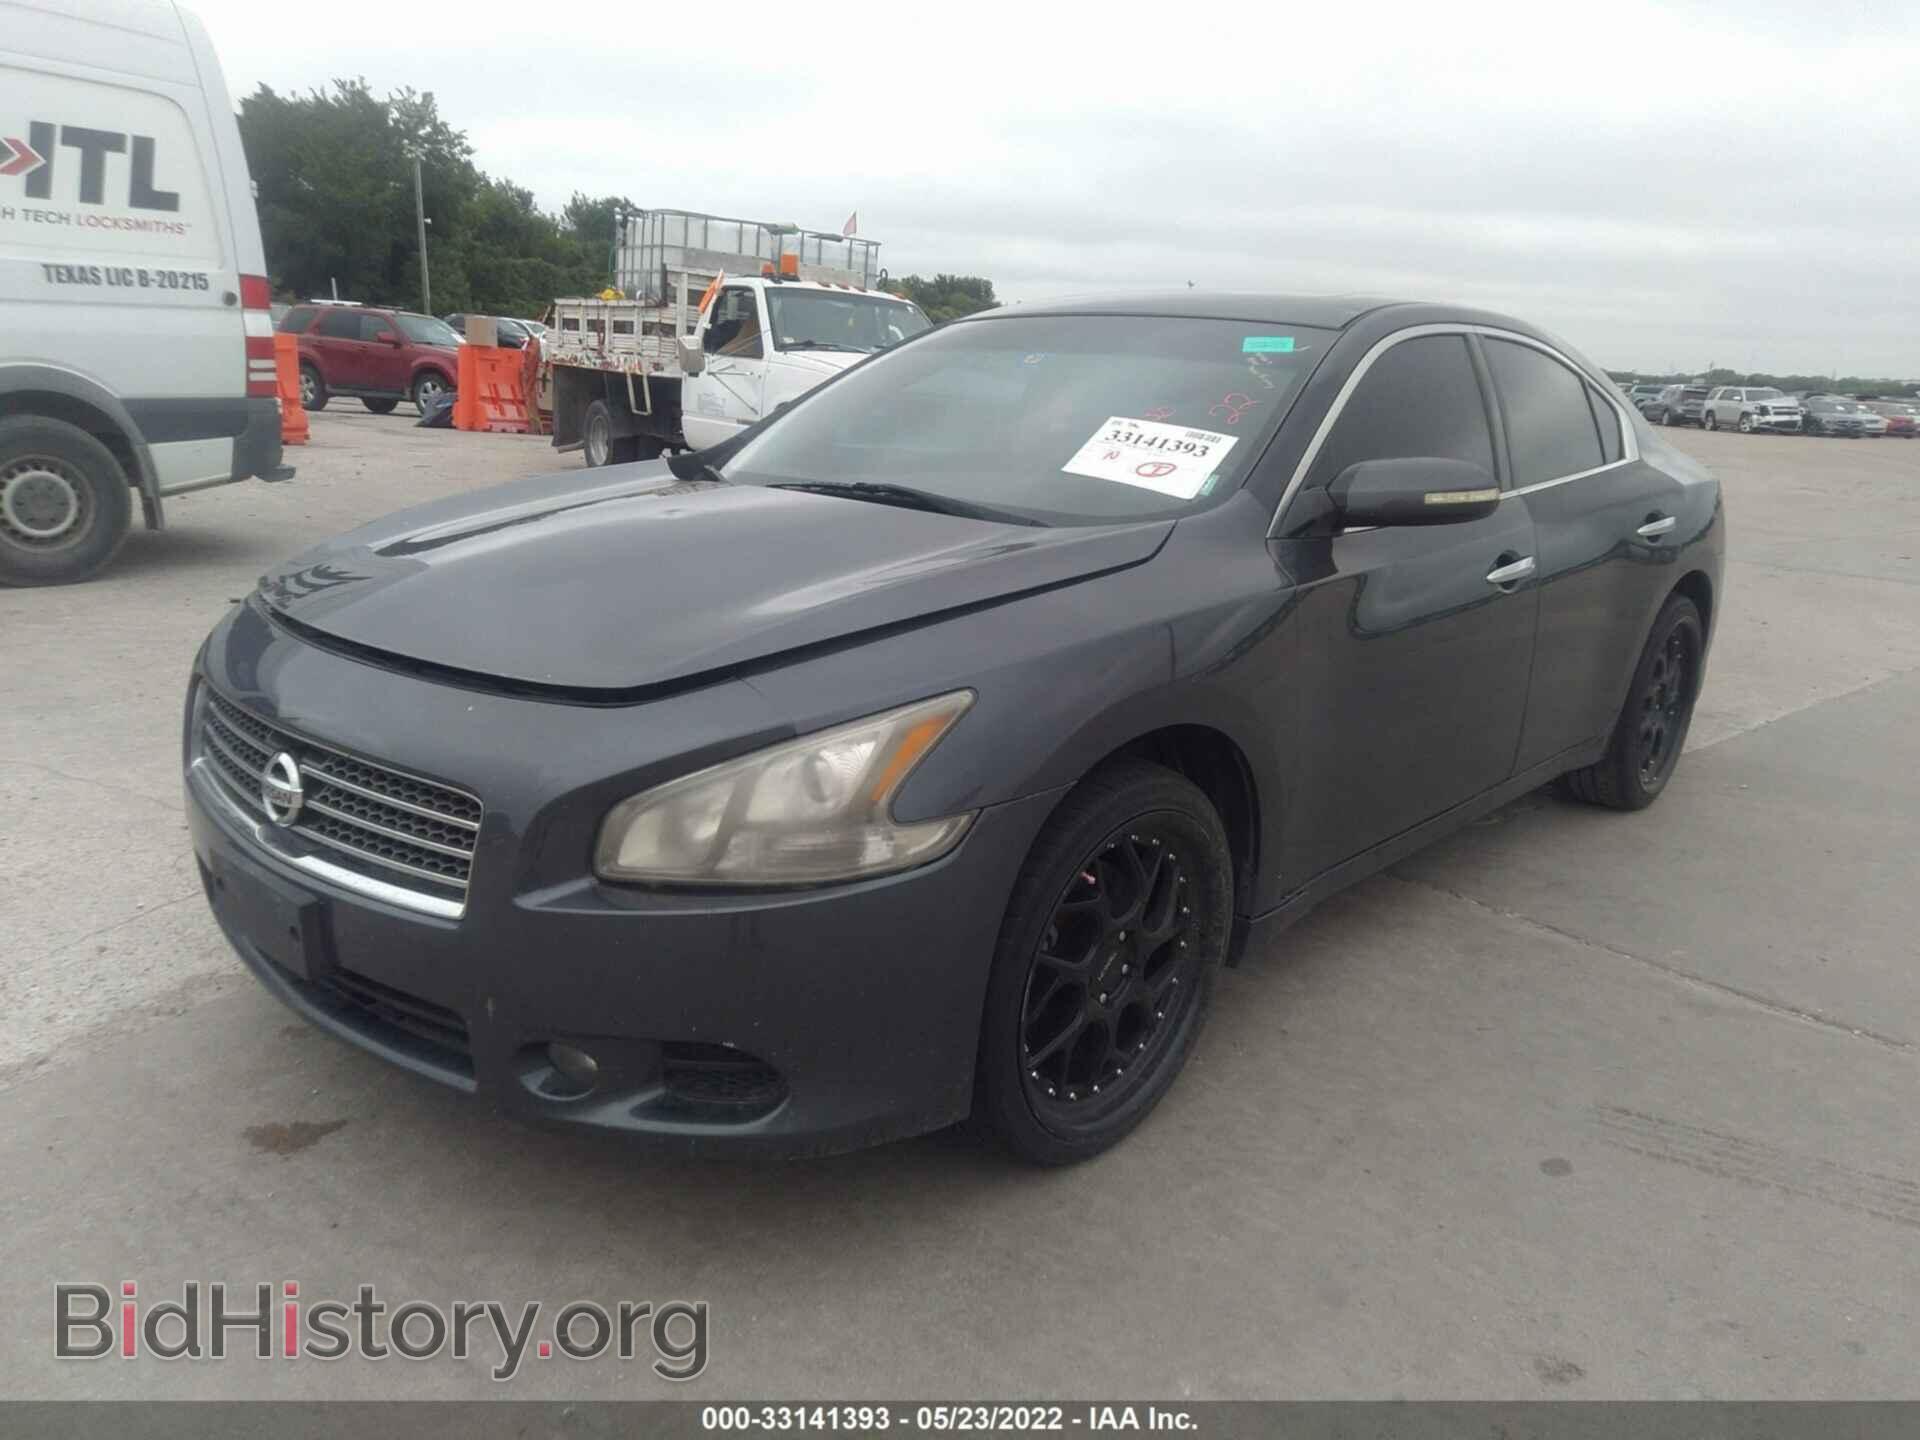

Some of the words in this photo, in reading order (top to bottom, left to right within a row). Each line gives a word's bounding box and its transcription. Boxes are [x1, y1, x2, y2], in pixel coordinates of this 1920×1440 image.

[22, 208, 71, 225] TECH
[77, 215, 186, 235] LOCKSMITHS
[41, 263, 102, 285] TEXAS
[105, 267, 134, 287] LIC
[138, 269, 209, 290] B-20215
[1104, 429, 1210, 458] 33141393
